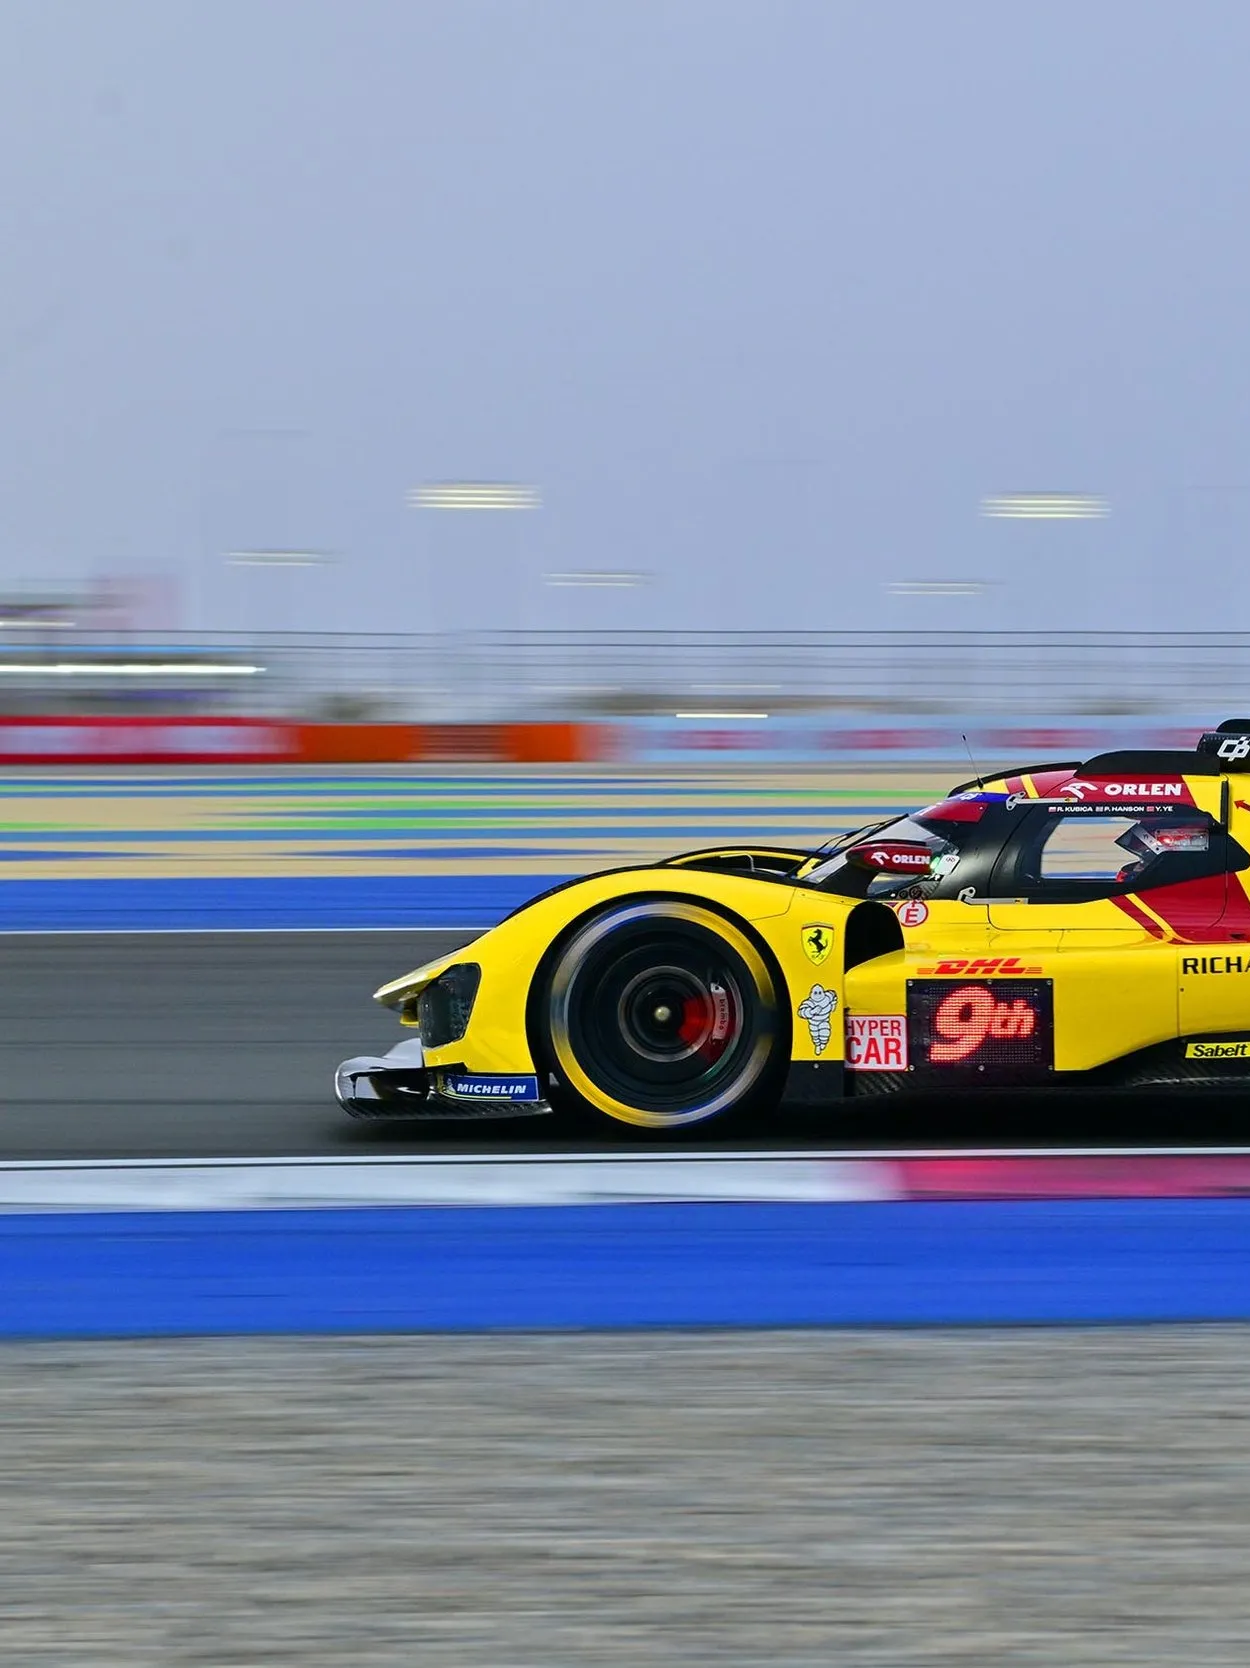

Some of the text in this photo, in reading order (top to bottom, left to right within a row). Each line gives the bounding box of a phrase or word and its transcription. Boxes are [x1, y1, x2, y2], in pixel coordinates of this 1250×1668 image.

[1104, 783, 1182, 796] ORLEN
[891, 854, 931, 865] ORLEN
[905, 908, 919, 923] E
[934, 958, 1027, 975] DHL
[845, 1020, 902, 1036] HYPER
[930, 985, 1035, 1062] 9th
[845, 1037, 902, 1065] CAR
[1193, 1043, 1248, 1057] Sabelt
[457, 1083, 527, 1094] MICHELIN
